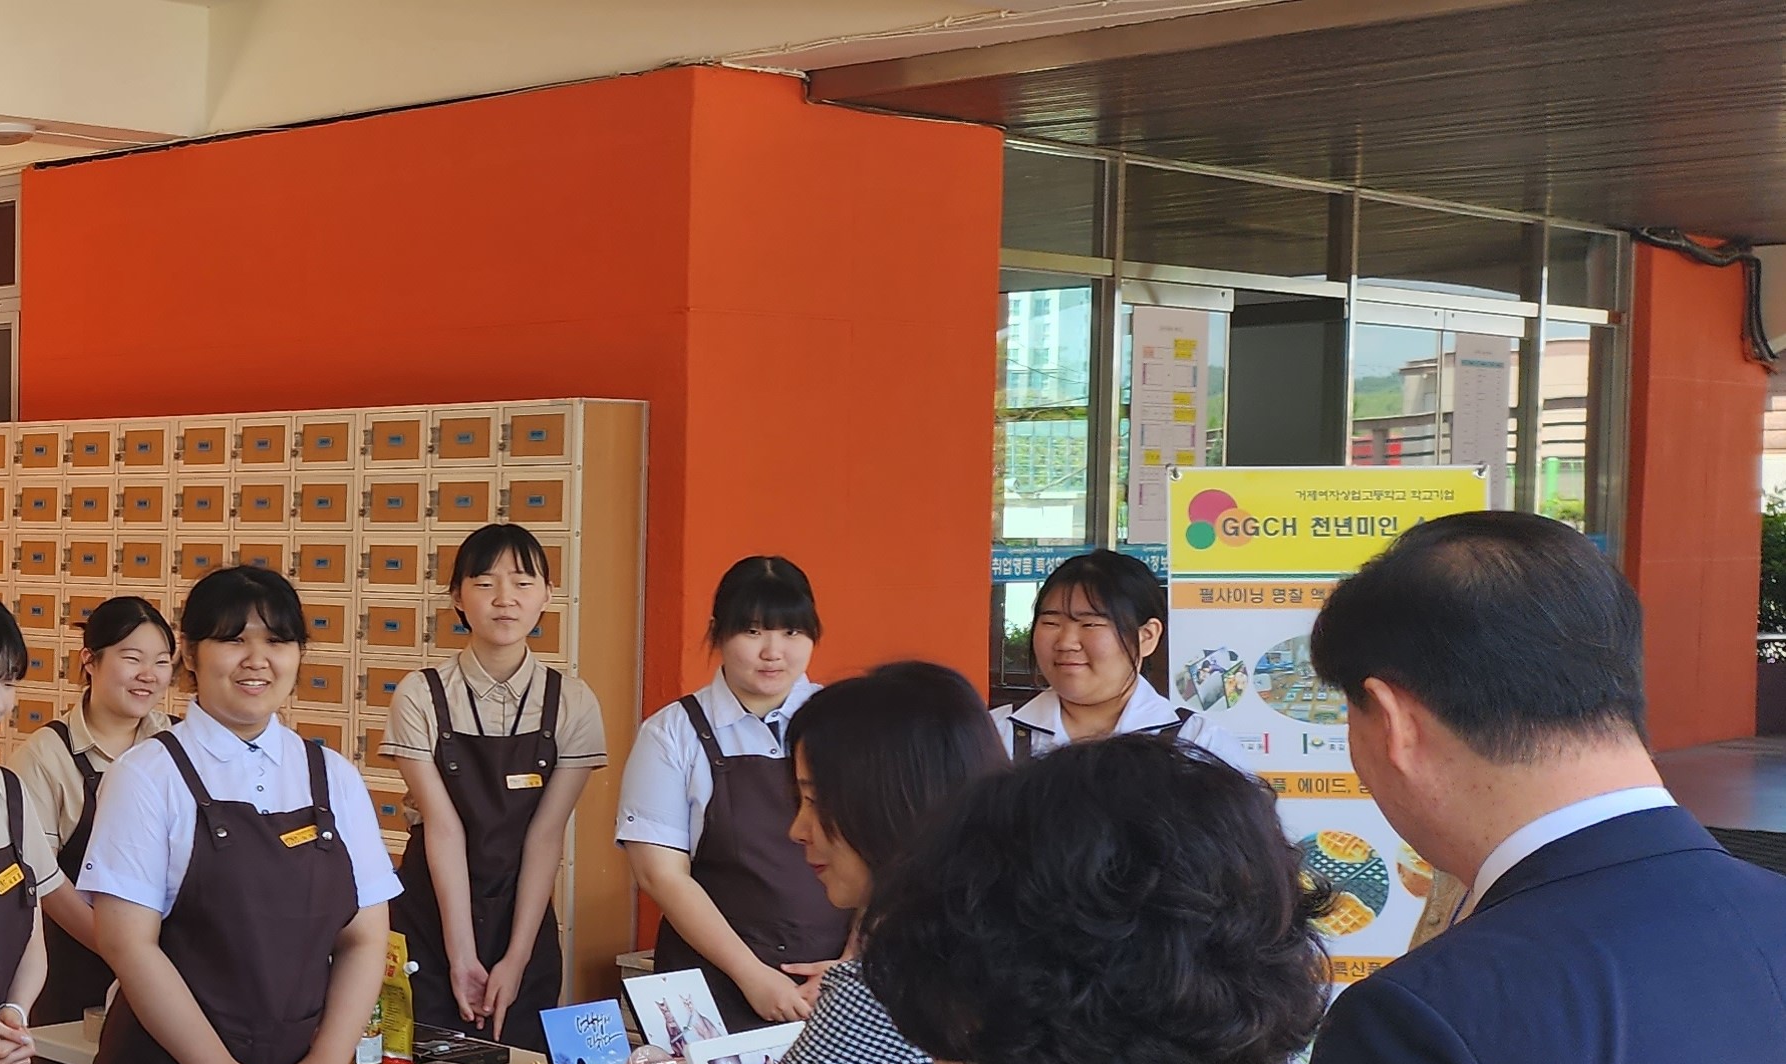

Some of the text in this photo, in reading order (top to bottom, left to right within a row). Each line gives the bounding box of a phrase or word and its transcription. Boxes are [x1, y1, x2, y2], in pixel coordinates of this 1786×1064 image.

[1295, 489, 1455, 501] 거제여자상업고등학교 학교기업
[1221, 515, 1399, 538] GGCH 천년미인
[1272, 587, 1303, 604] 명찰
